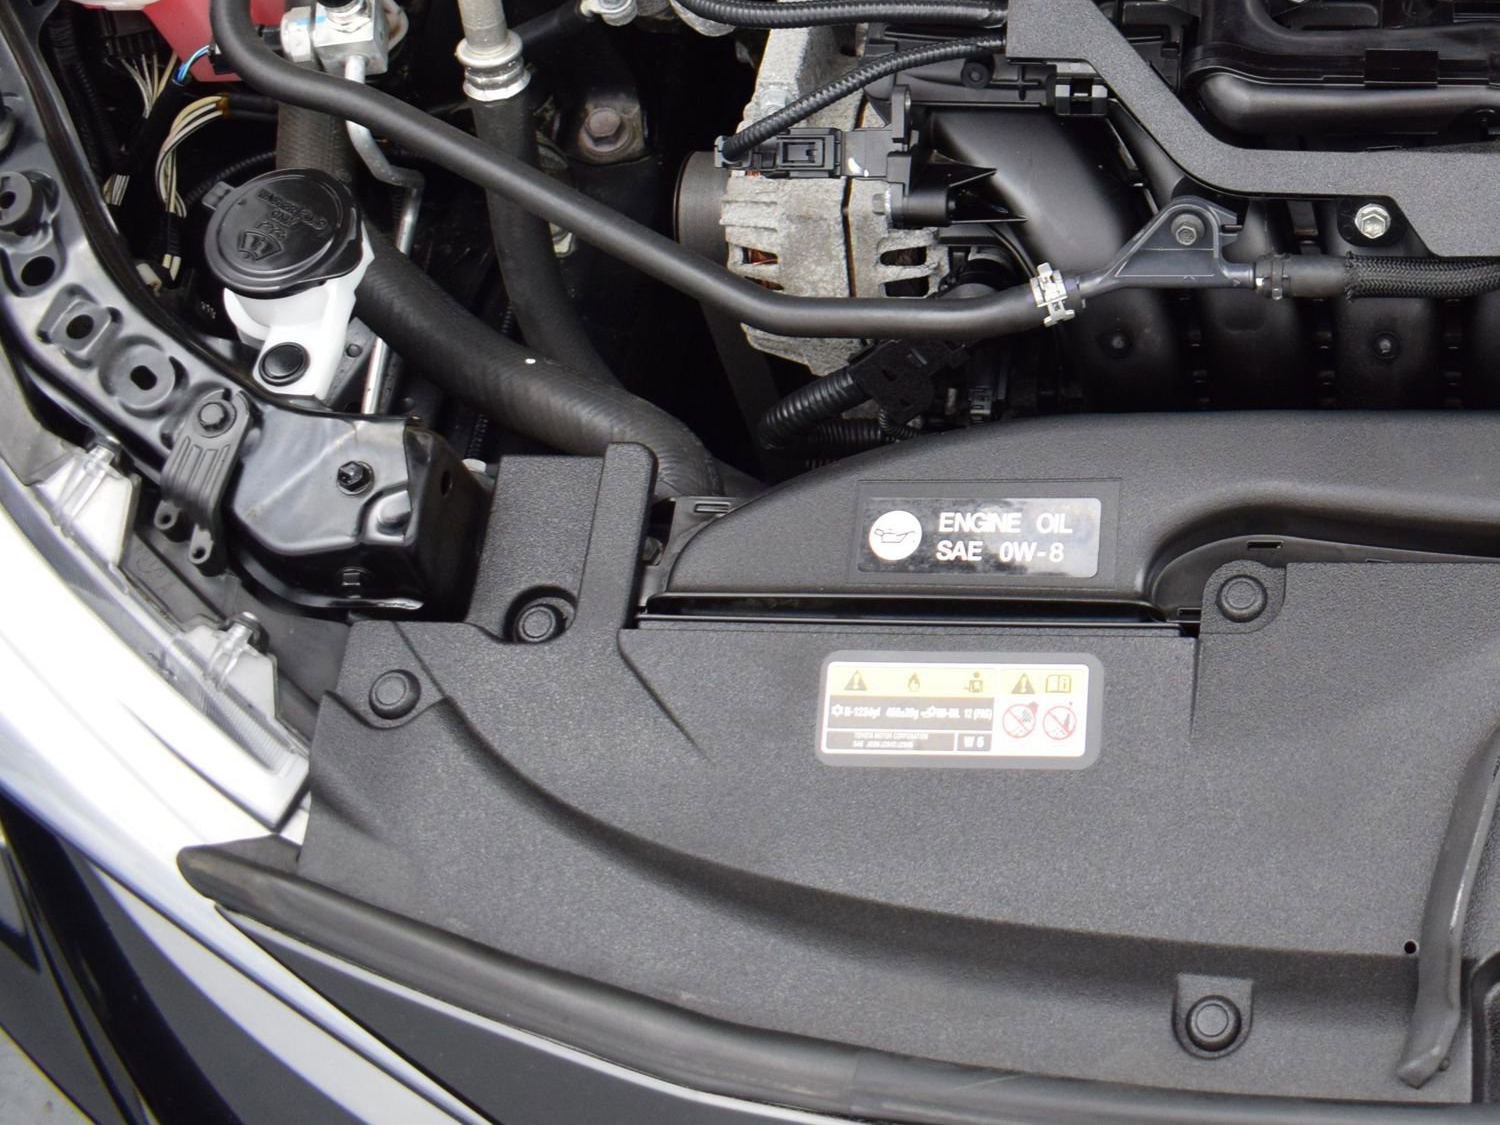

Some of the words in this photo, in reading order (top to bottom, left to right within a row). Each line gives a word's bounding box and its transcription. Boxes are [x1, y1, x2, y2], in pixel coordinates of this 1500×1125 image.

[939, 512, 1022, 533] ENGINE
[1036, 513, 1073, 534] OIL
[936, 540, 983, 561] SAE
[999, 541, 1064, 563] 0W-8
